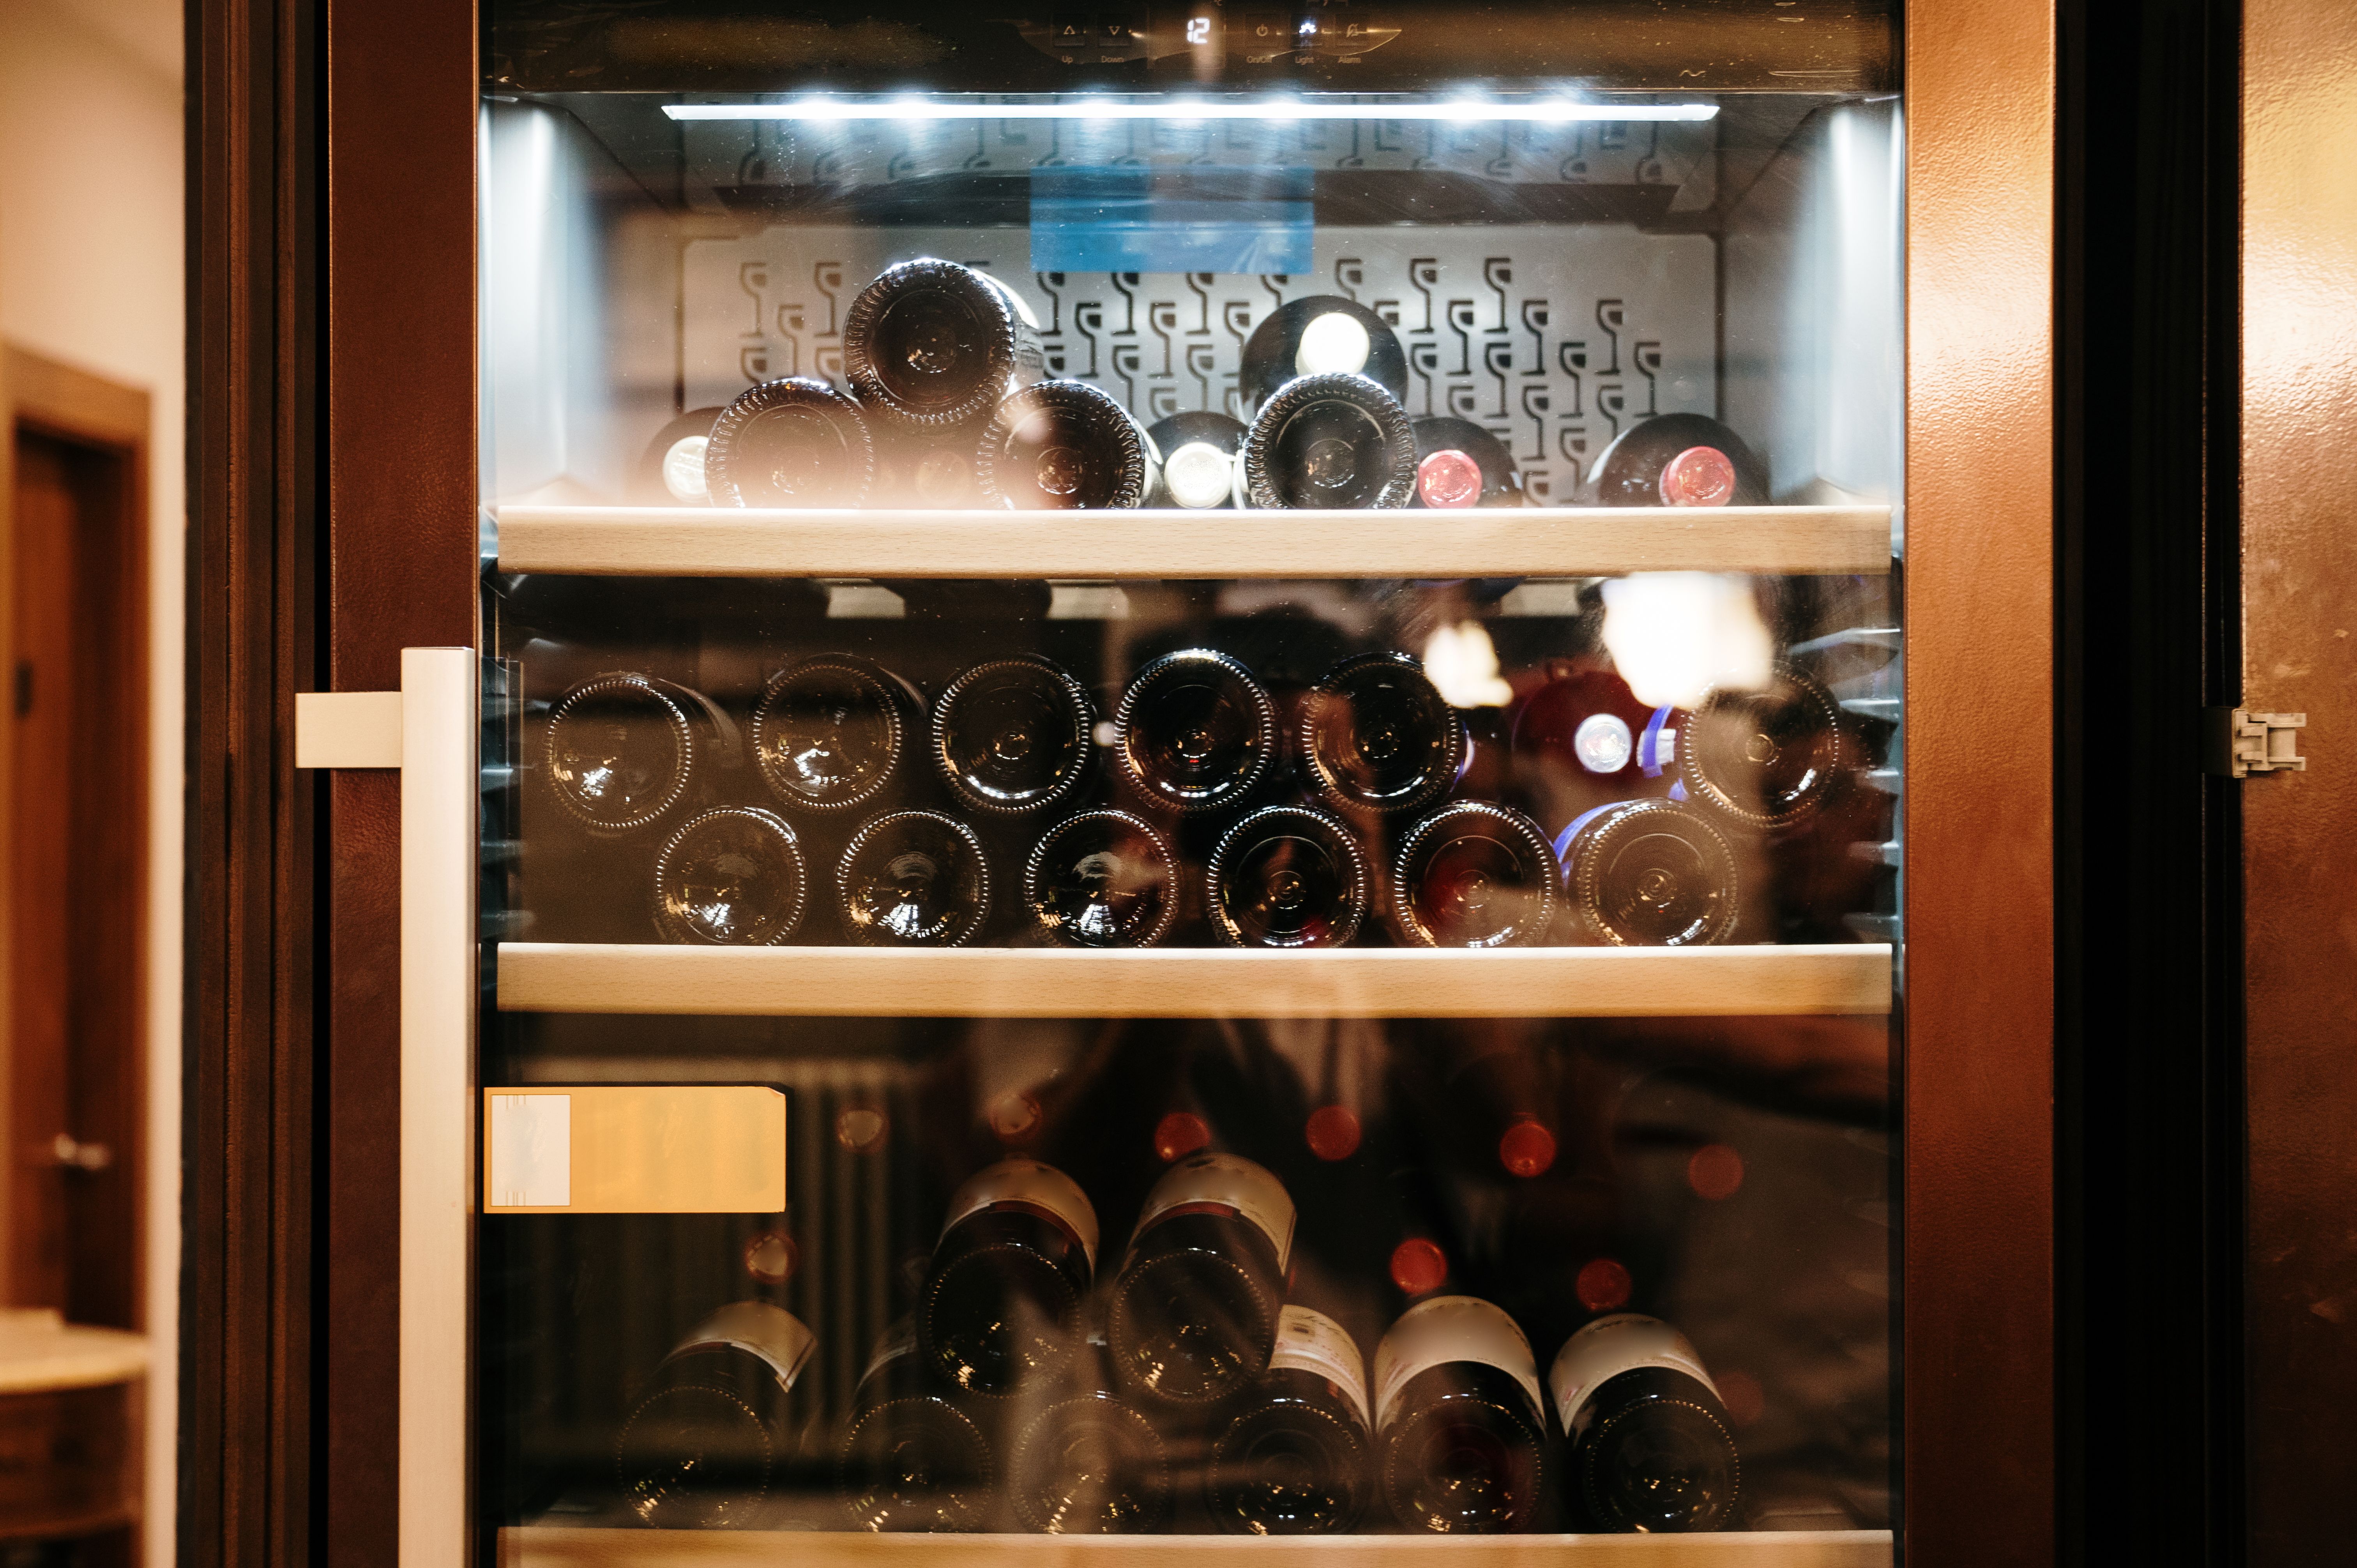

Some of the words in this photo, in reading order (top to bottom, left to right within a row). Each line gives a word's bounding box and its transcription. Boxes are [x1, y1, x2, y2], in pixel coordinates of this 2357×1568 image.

[1187, 18, 1210, 43] 12
[1062, 55, 1073, 65] Up
[1295, 56, 1314, 65] Light
